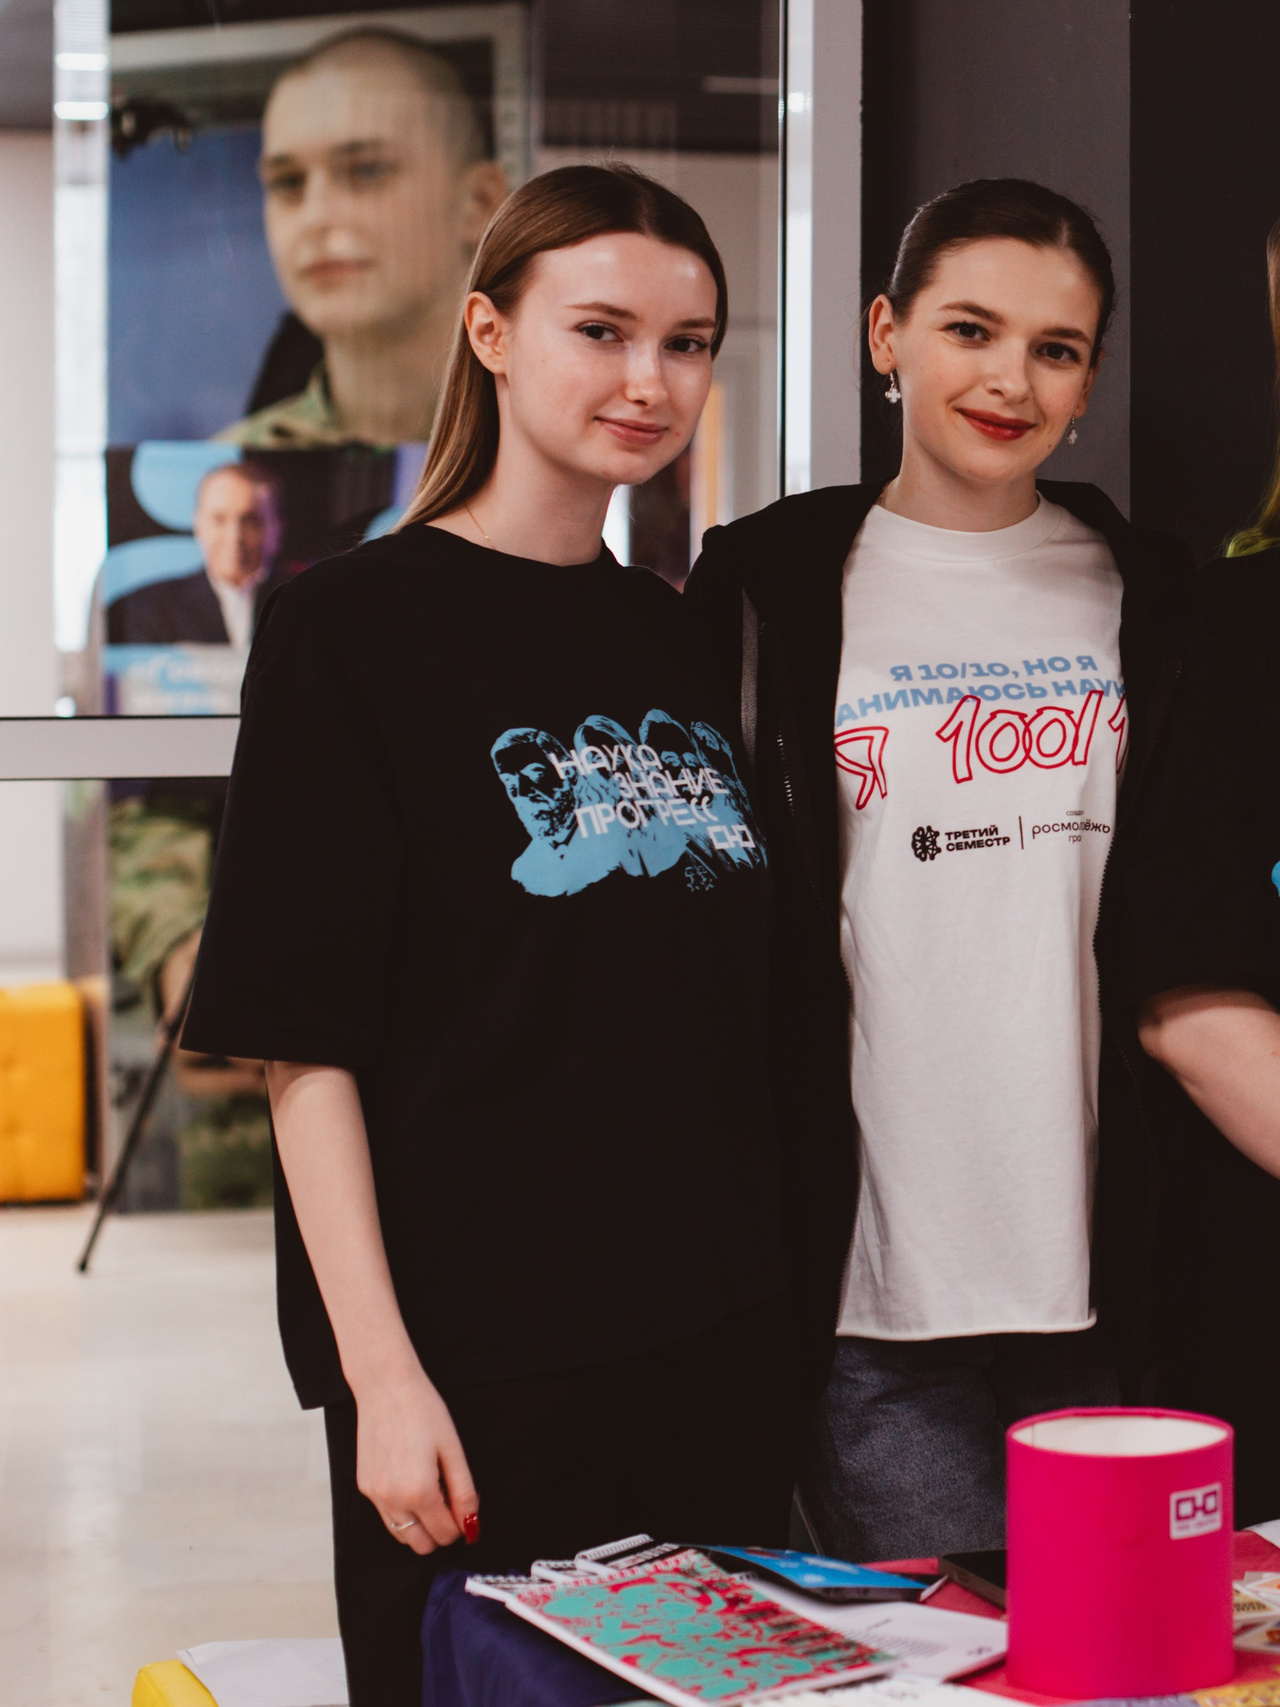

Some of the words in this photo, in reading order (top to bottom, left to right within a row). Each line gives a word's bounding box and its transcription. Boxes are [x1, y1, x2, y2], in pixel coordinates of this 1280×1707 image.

[889, 664, 914, 682] Я
[917, 662, 1020, 681] 10/10,
[1022, 656, 1072, 677] НО
[1075, 655, 1099, 671] Я
[835, 682, 1048, 728] АНИМАЮСЬ
[549, 744, 664, 780] НАУКА
[613, 767, 730, 800] ЗНАНИЕ
[573, 795, 719, 839] ПРОГРЕСС
[944, 824, 1000, 841] ТРЕТИЙ
[945, 836, 1011, 852] СЕМЕСТР
